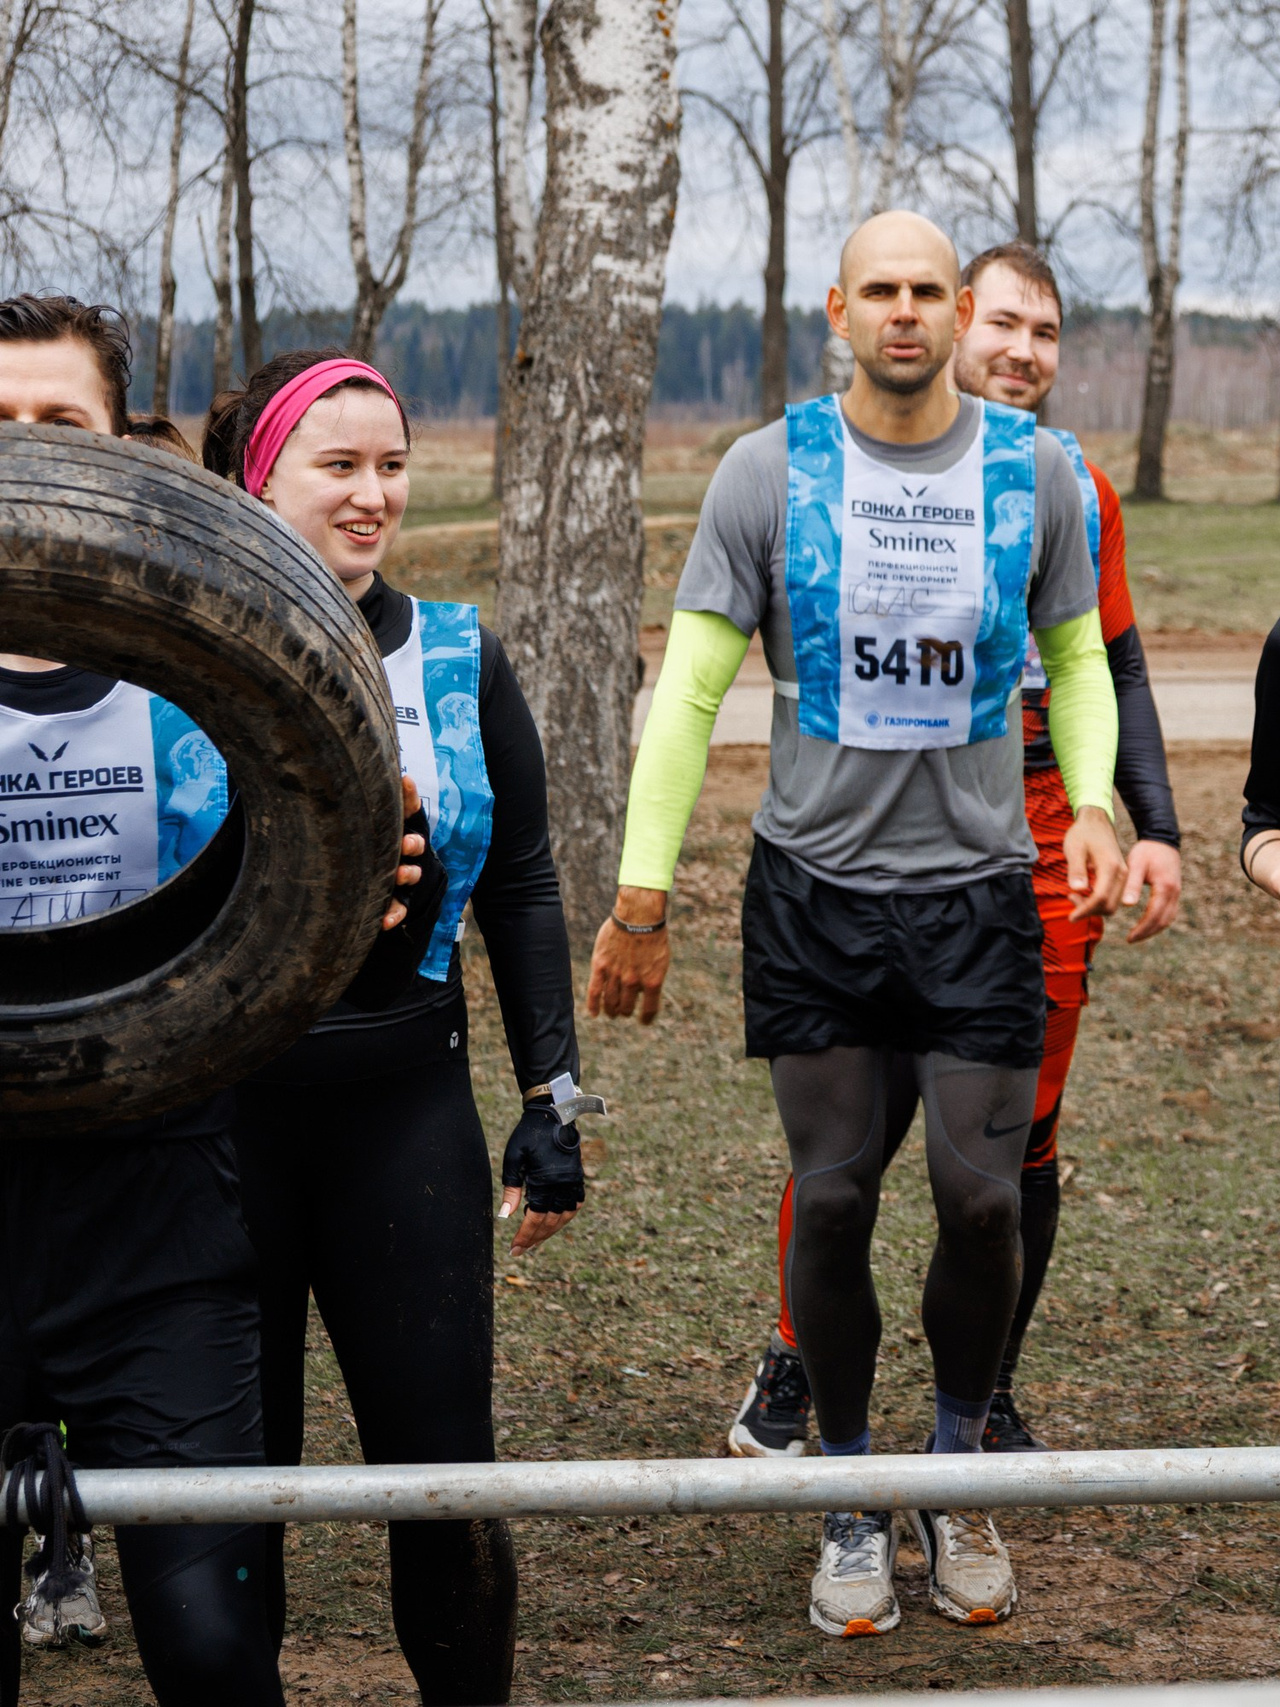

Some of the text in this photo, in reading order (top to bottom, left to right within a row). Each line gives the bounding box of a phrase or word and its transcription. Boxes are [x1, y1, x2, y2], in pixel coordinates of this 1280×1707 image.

[852, 501, 975, 521] ГОНКА ГЕРОЕВ
[869, 528, 956, 553] Sminex
[868, 561, 958, 573] ПЕРФЕКЦИОНИСТЫ
[868, 572, 957, 585] FINE DEVELOPMENT
[855, 636, 964, 686] 5410
[884, 716, 950, 729] ГАЗПРОМБАНК
[49, 766, 143, 789] ГЕРОЕВ
[0, 855, 121, 872] ЕРФЕКЦИОНИСТЫ
[0, 871, 122, 889] INE DEVELOPMENT
